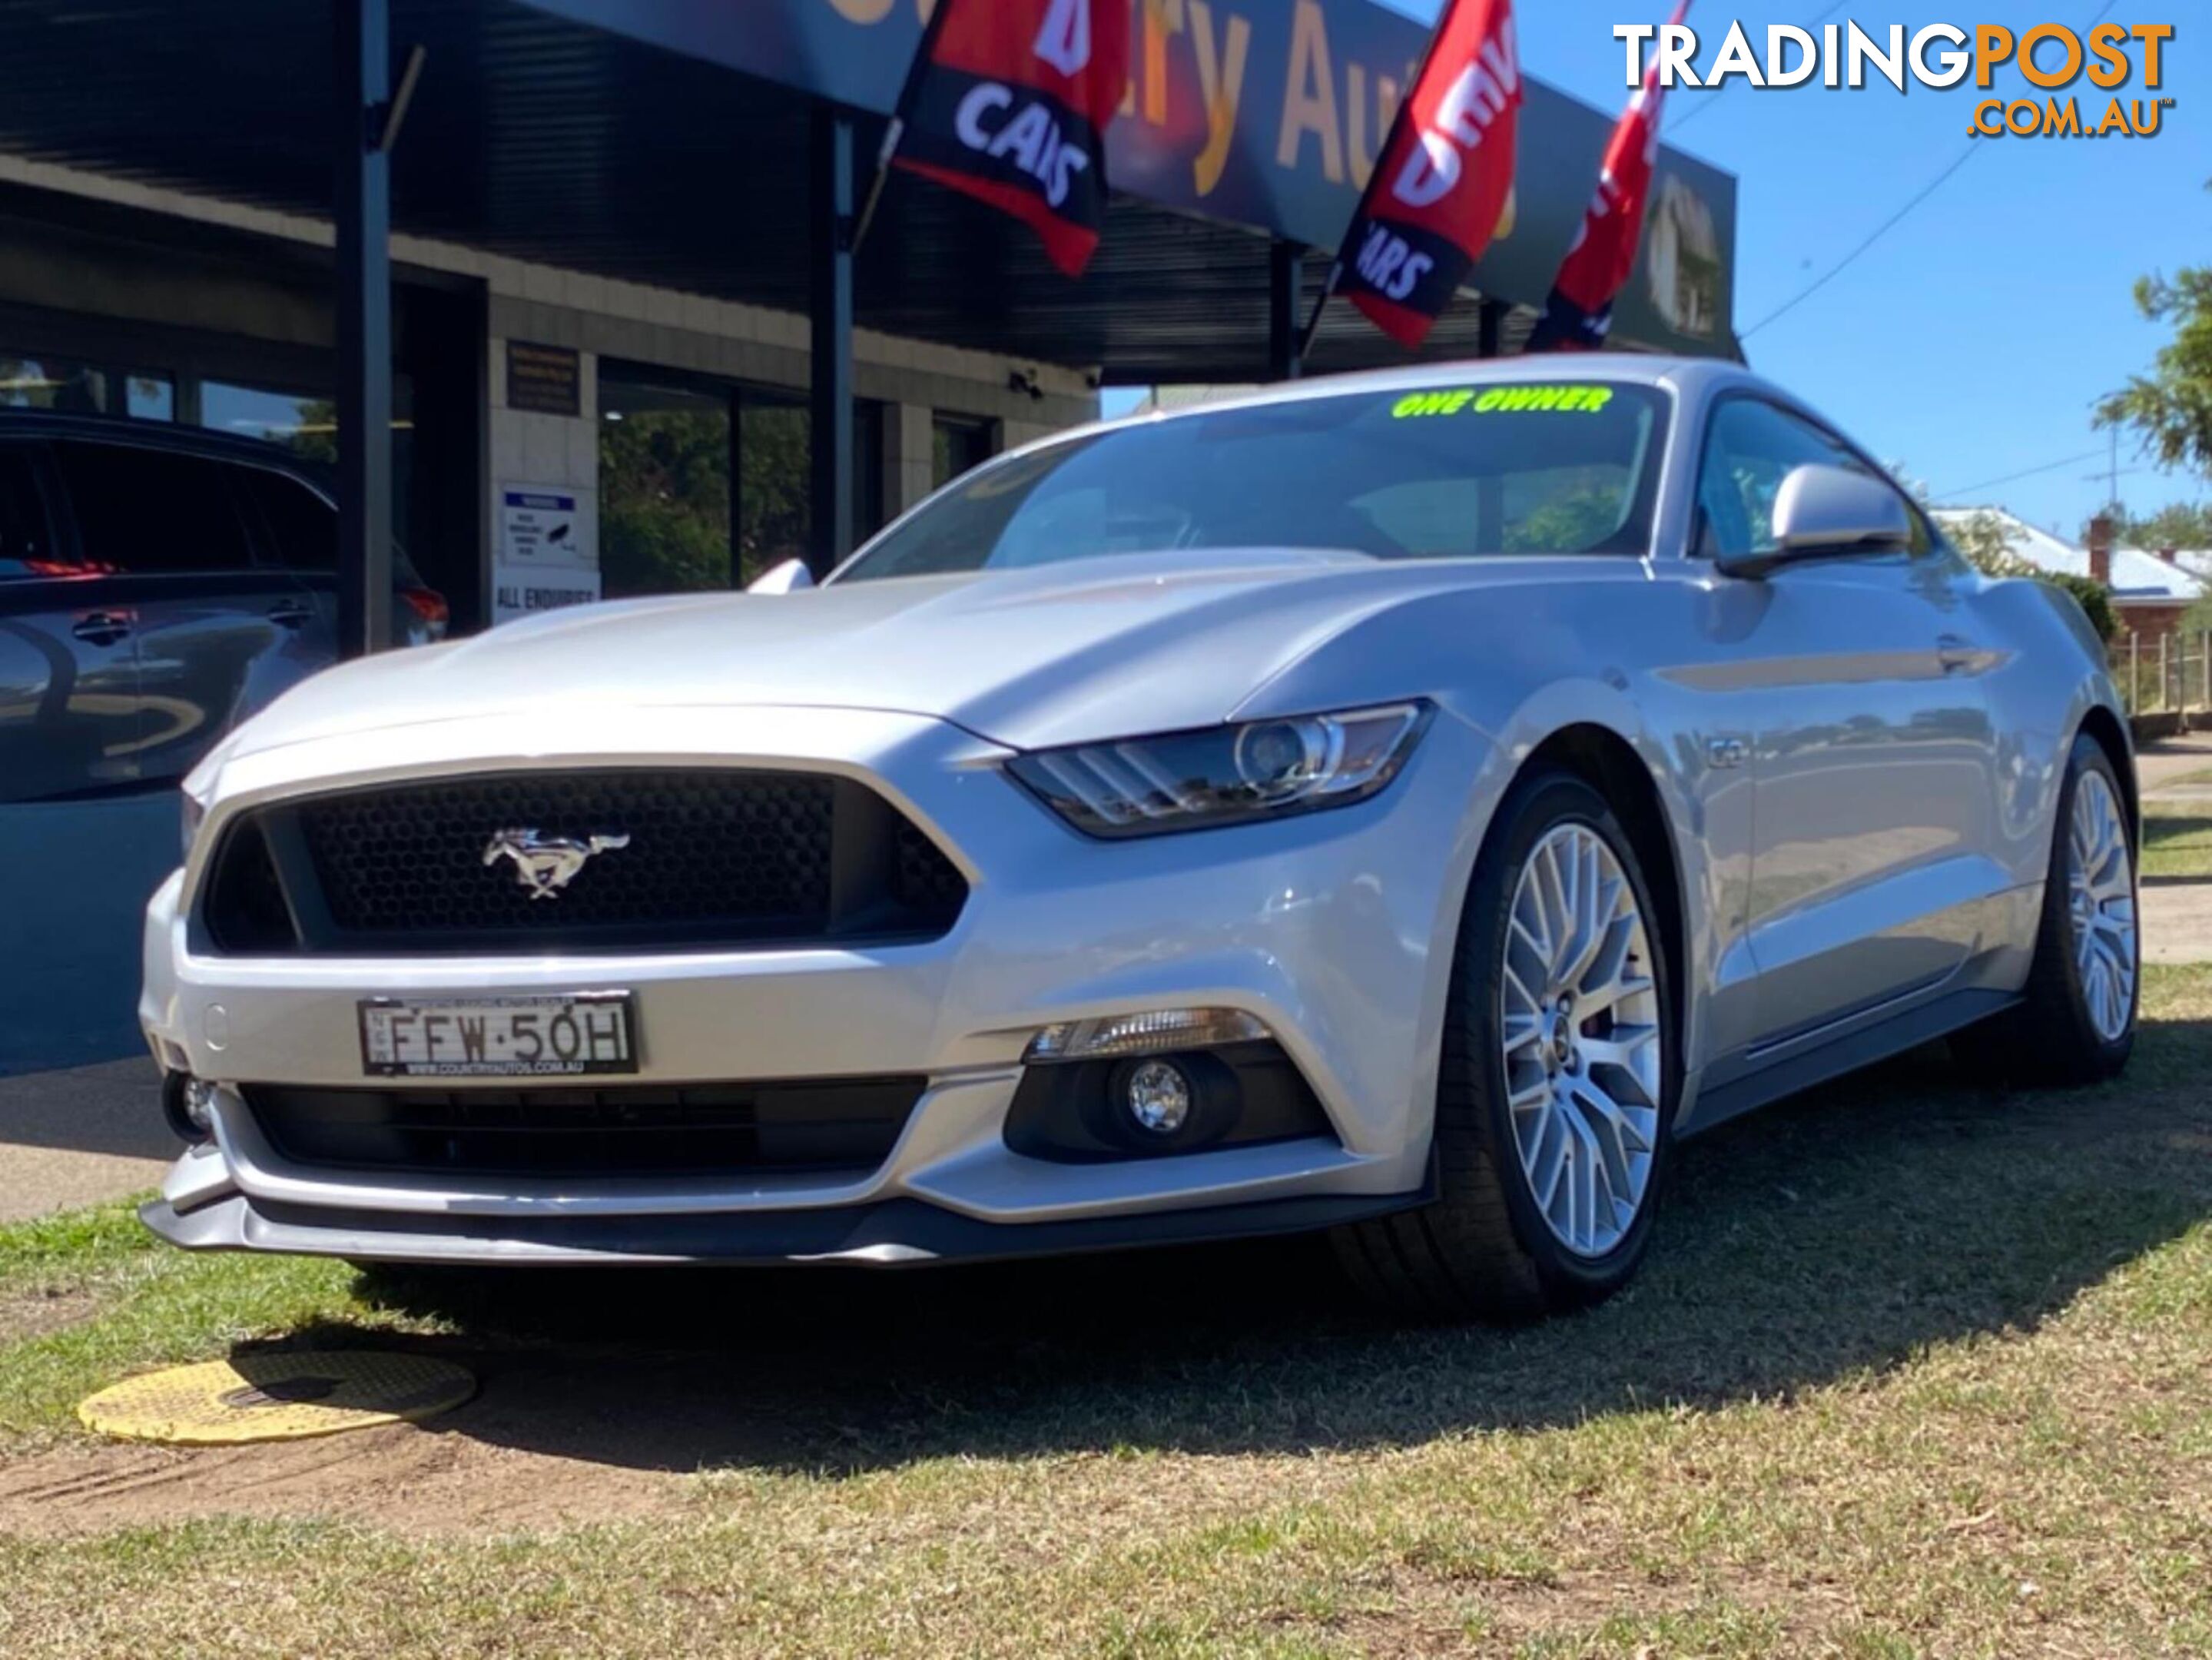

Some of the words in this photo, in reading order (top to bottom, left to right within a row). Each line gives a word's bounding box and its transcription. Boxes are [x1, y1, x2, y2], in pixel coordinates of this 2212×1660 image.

[1355, 221, 1434, 300] ARS
[1392, 388, 1476, 418] ONE
[1474, 386, 1613, 413] OWNER
[498, 586, 519, 609] ALL
